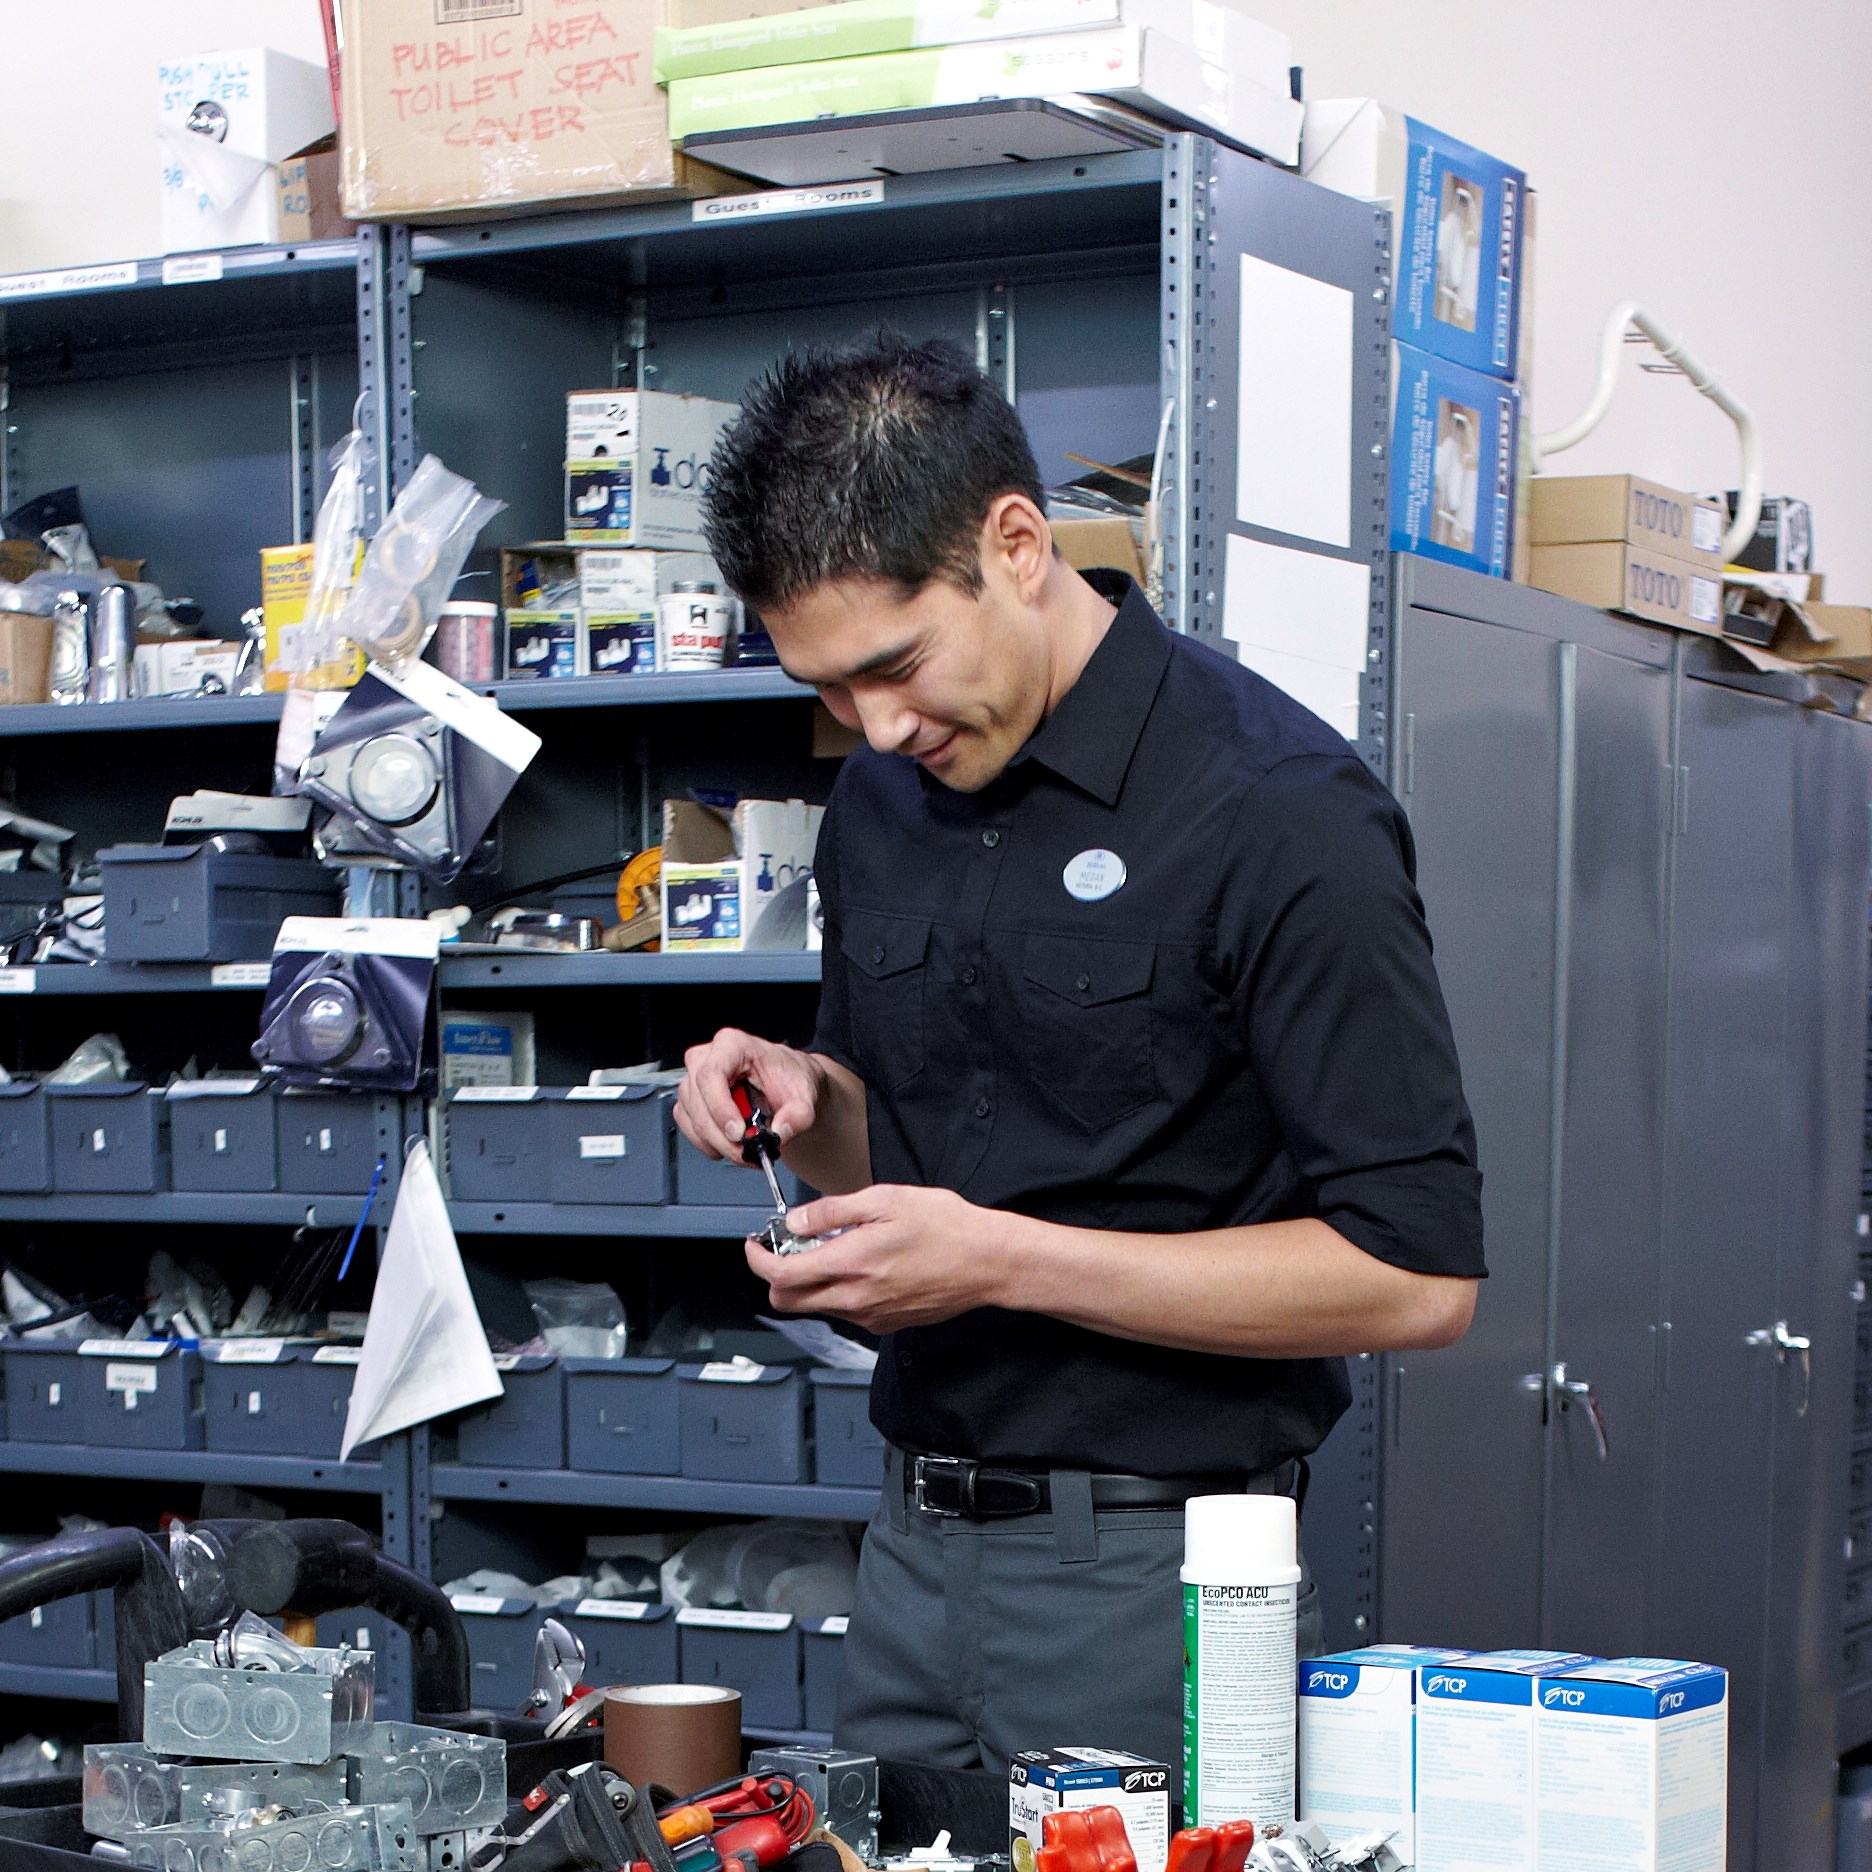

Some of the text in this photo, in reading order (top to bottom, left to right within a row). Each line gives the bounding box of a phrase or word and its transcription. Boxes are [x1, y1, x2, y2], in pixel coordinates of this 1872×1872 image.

[391, 30, 512, 77] PUBLIC
[526, 11, 617, 58] AREA
[390, 52, 640, 121] TOILET SEAT
[444, 103, 586, 147] COVER
[1635, 490, 1684, 538] TOTO
[1630, 563, 1680, 610] TOTO
[1202, 1585, 1269, 1599] EcoPCO ACU
[1235, 1600, 1263, 1608] CONTACT
[1324, 1673, 1349, 1691] TCP
[1442, 1677, 1467, 1695] TCP
[1560, 1690, 1586, 1707] TCP
[1669, 1692, 1685, 1710] TCP
[1142, 1771, 1166, 1787] TCP
[1011, 1796, 1039, 1823] TruStart
